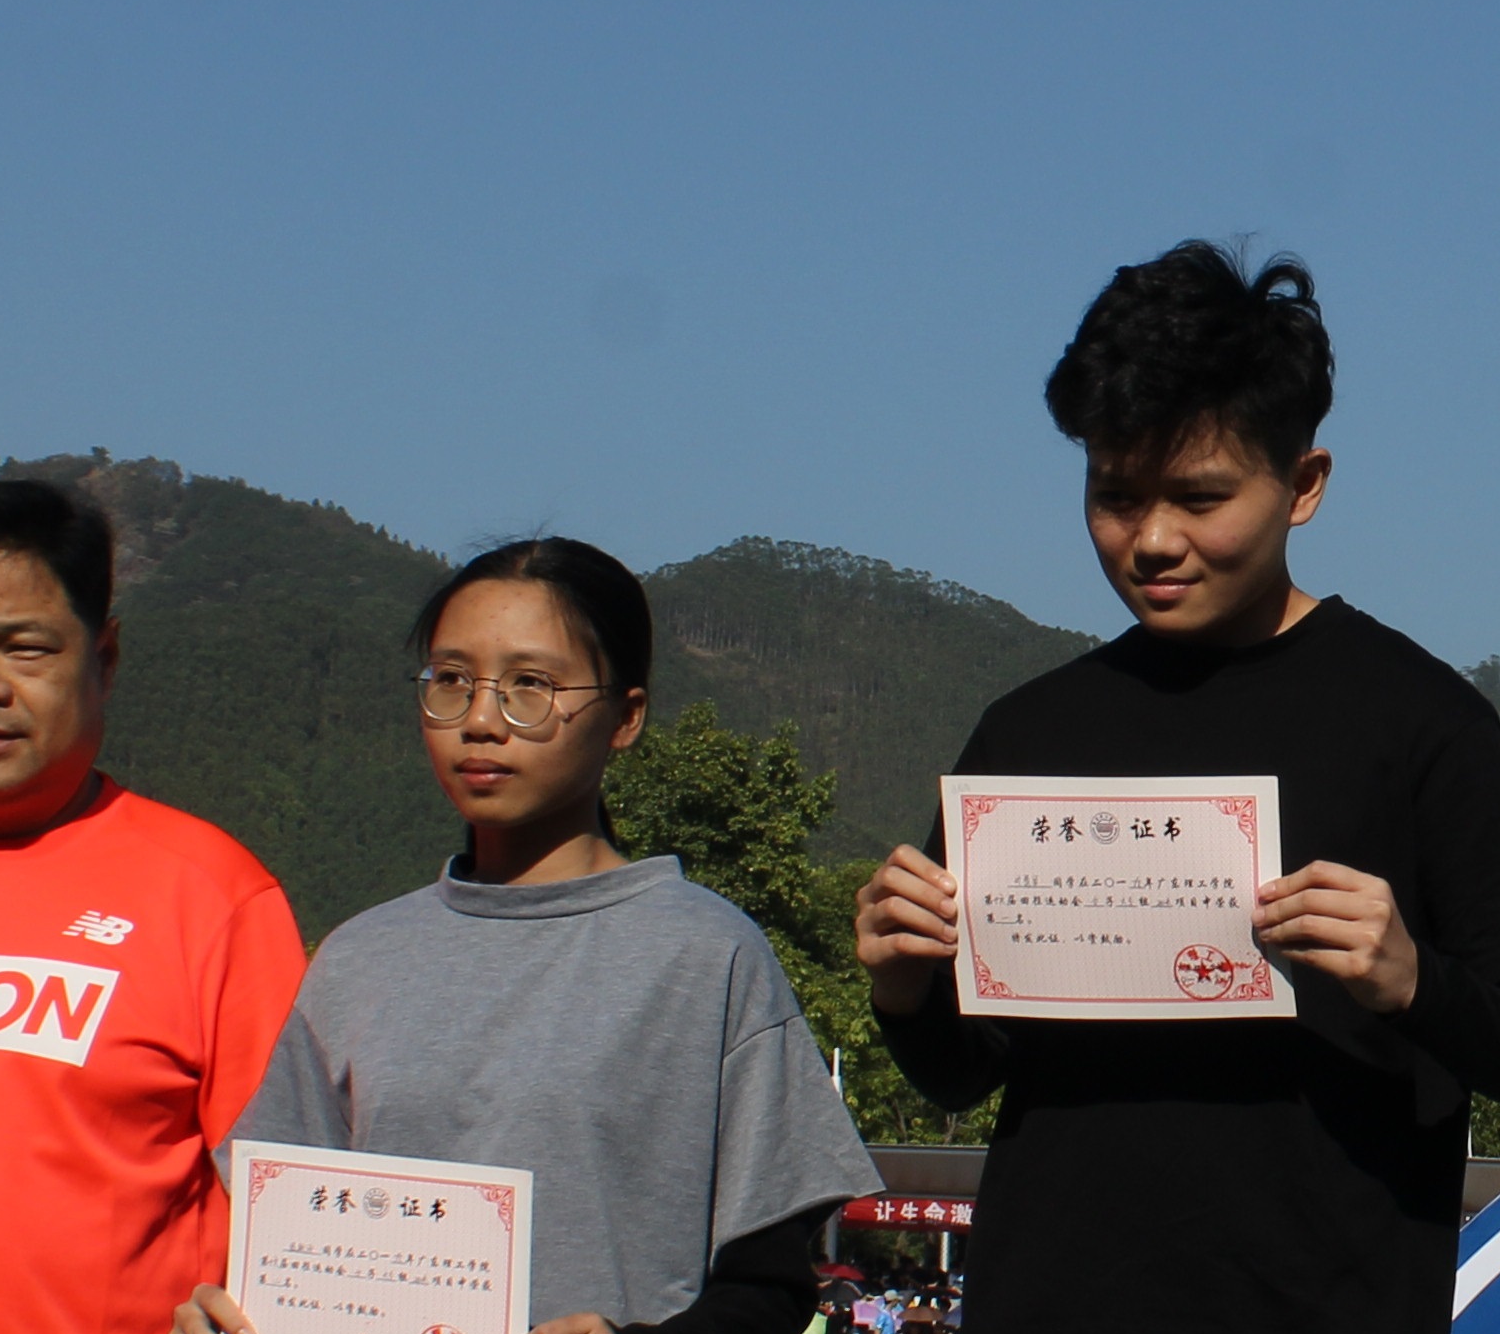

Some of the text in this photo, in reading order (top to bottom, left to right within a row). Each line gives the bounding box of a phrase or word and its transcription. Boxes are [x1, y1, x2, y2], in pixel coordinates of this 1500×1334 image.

[1031, 815, 1182, 843] 荣誉 证书
[308, 1185, 448, 1222] 荣誉 证书
